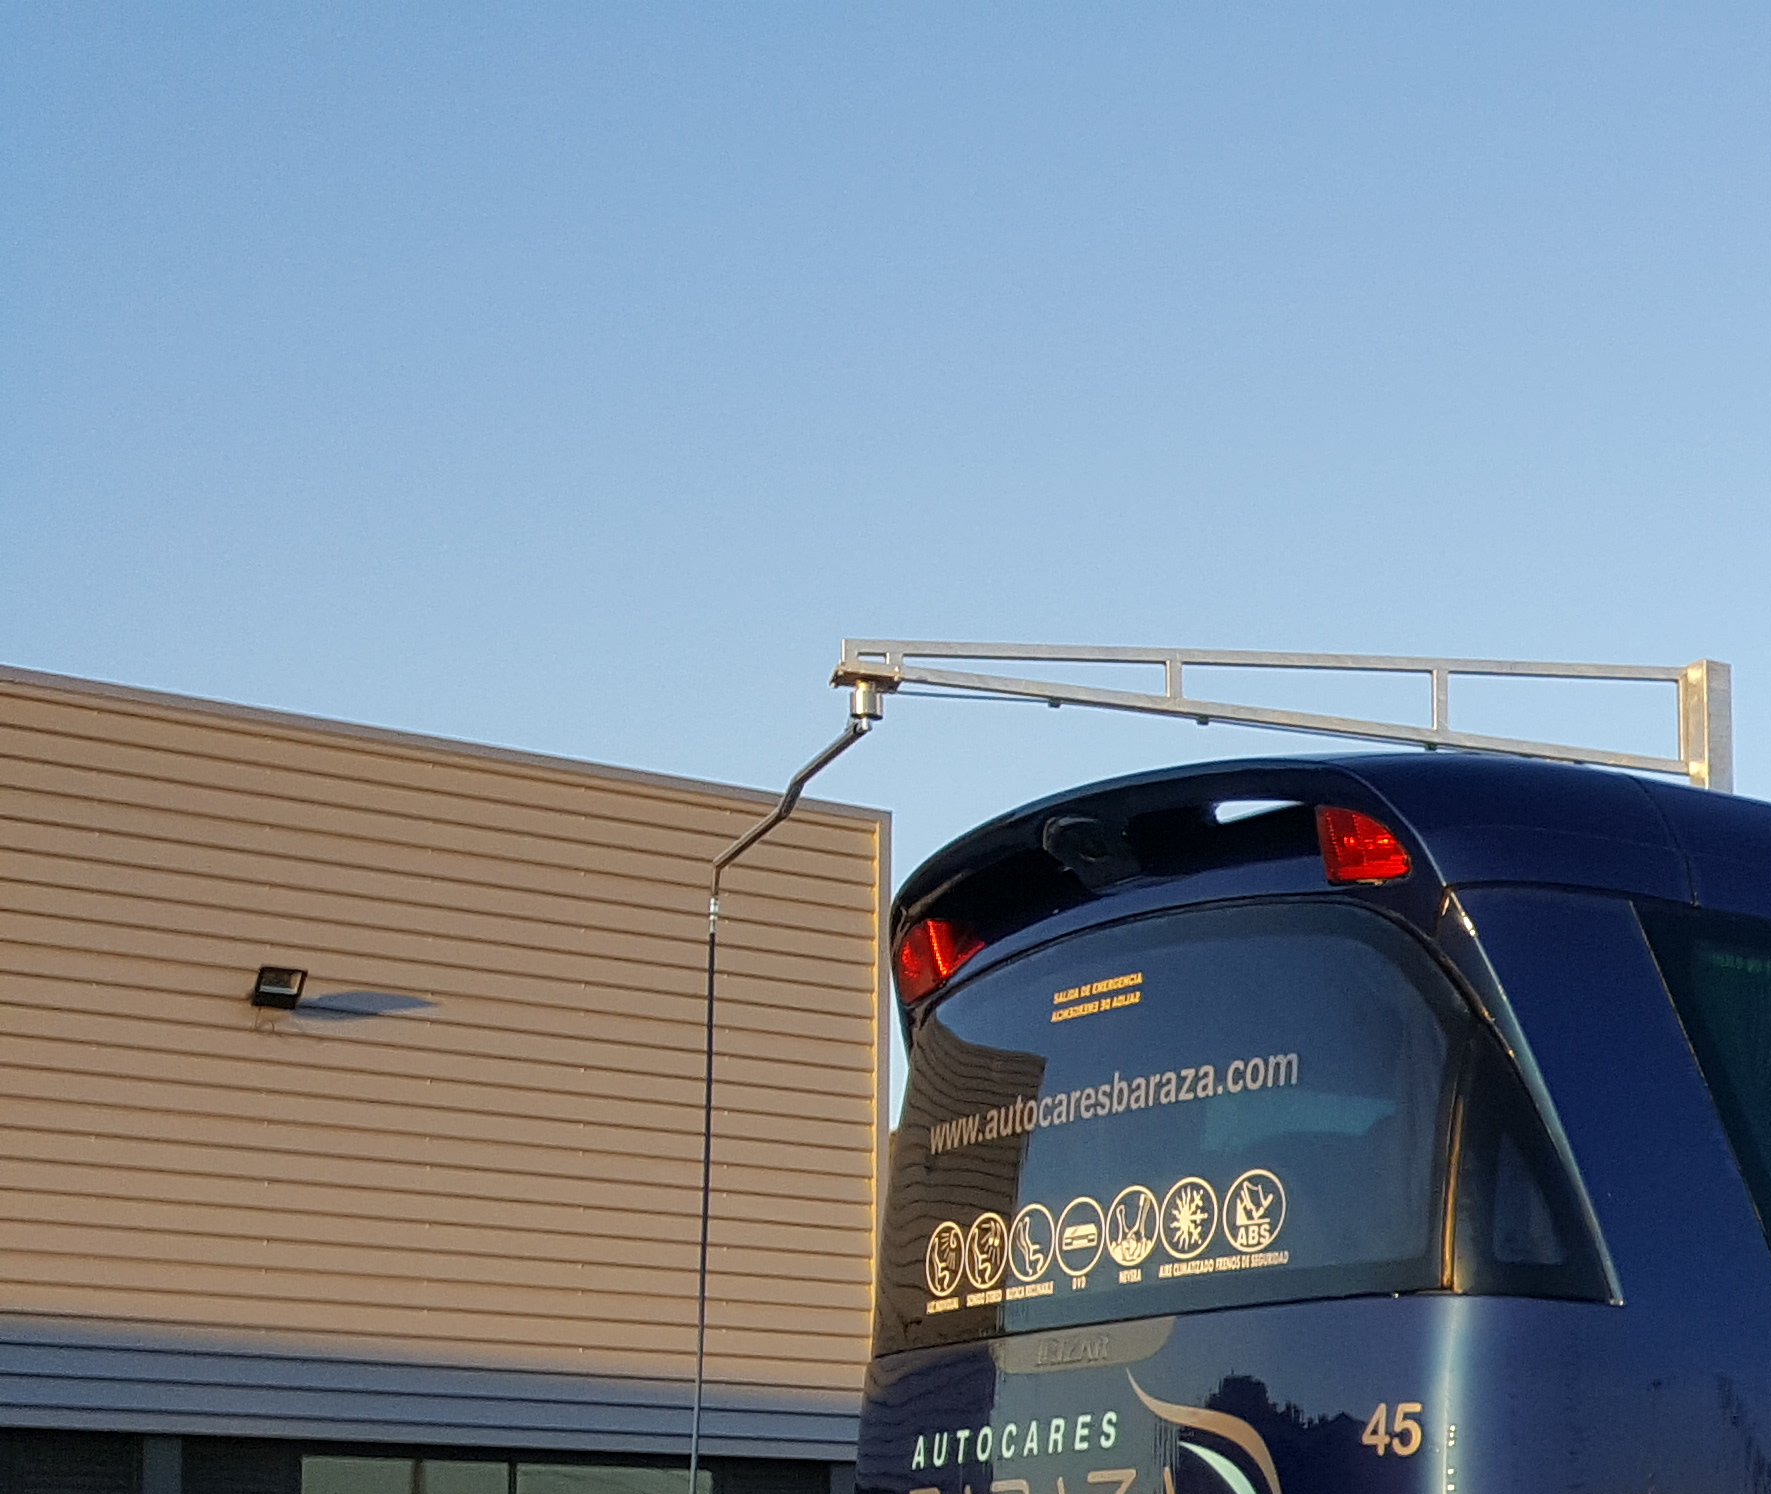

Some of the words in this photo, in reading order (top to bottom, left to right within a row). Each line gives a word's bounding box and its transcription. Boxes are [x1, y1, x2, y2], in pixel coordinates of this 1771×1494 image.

[930, 1052, 1299, 1155] www.autocaresbaraza.com
[1237, 1224, 1271, 1246] ABS
[911, 1410, 1118, 1471] AUTOCARES
[1362, 1402, 1423, 1456] 45
